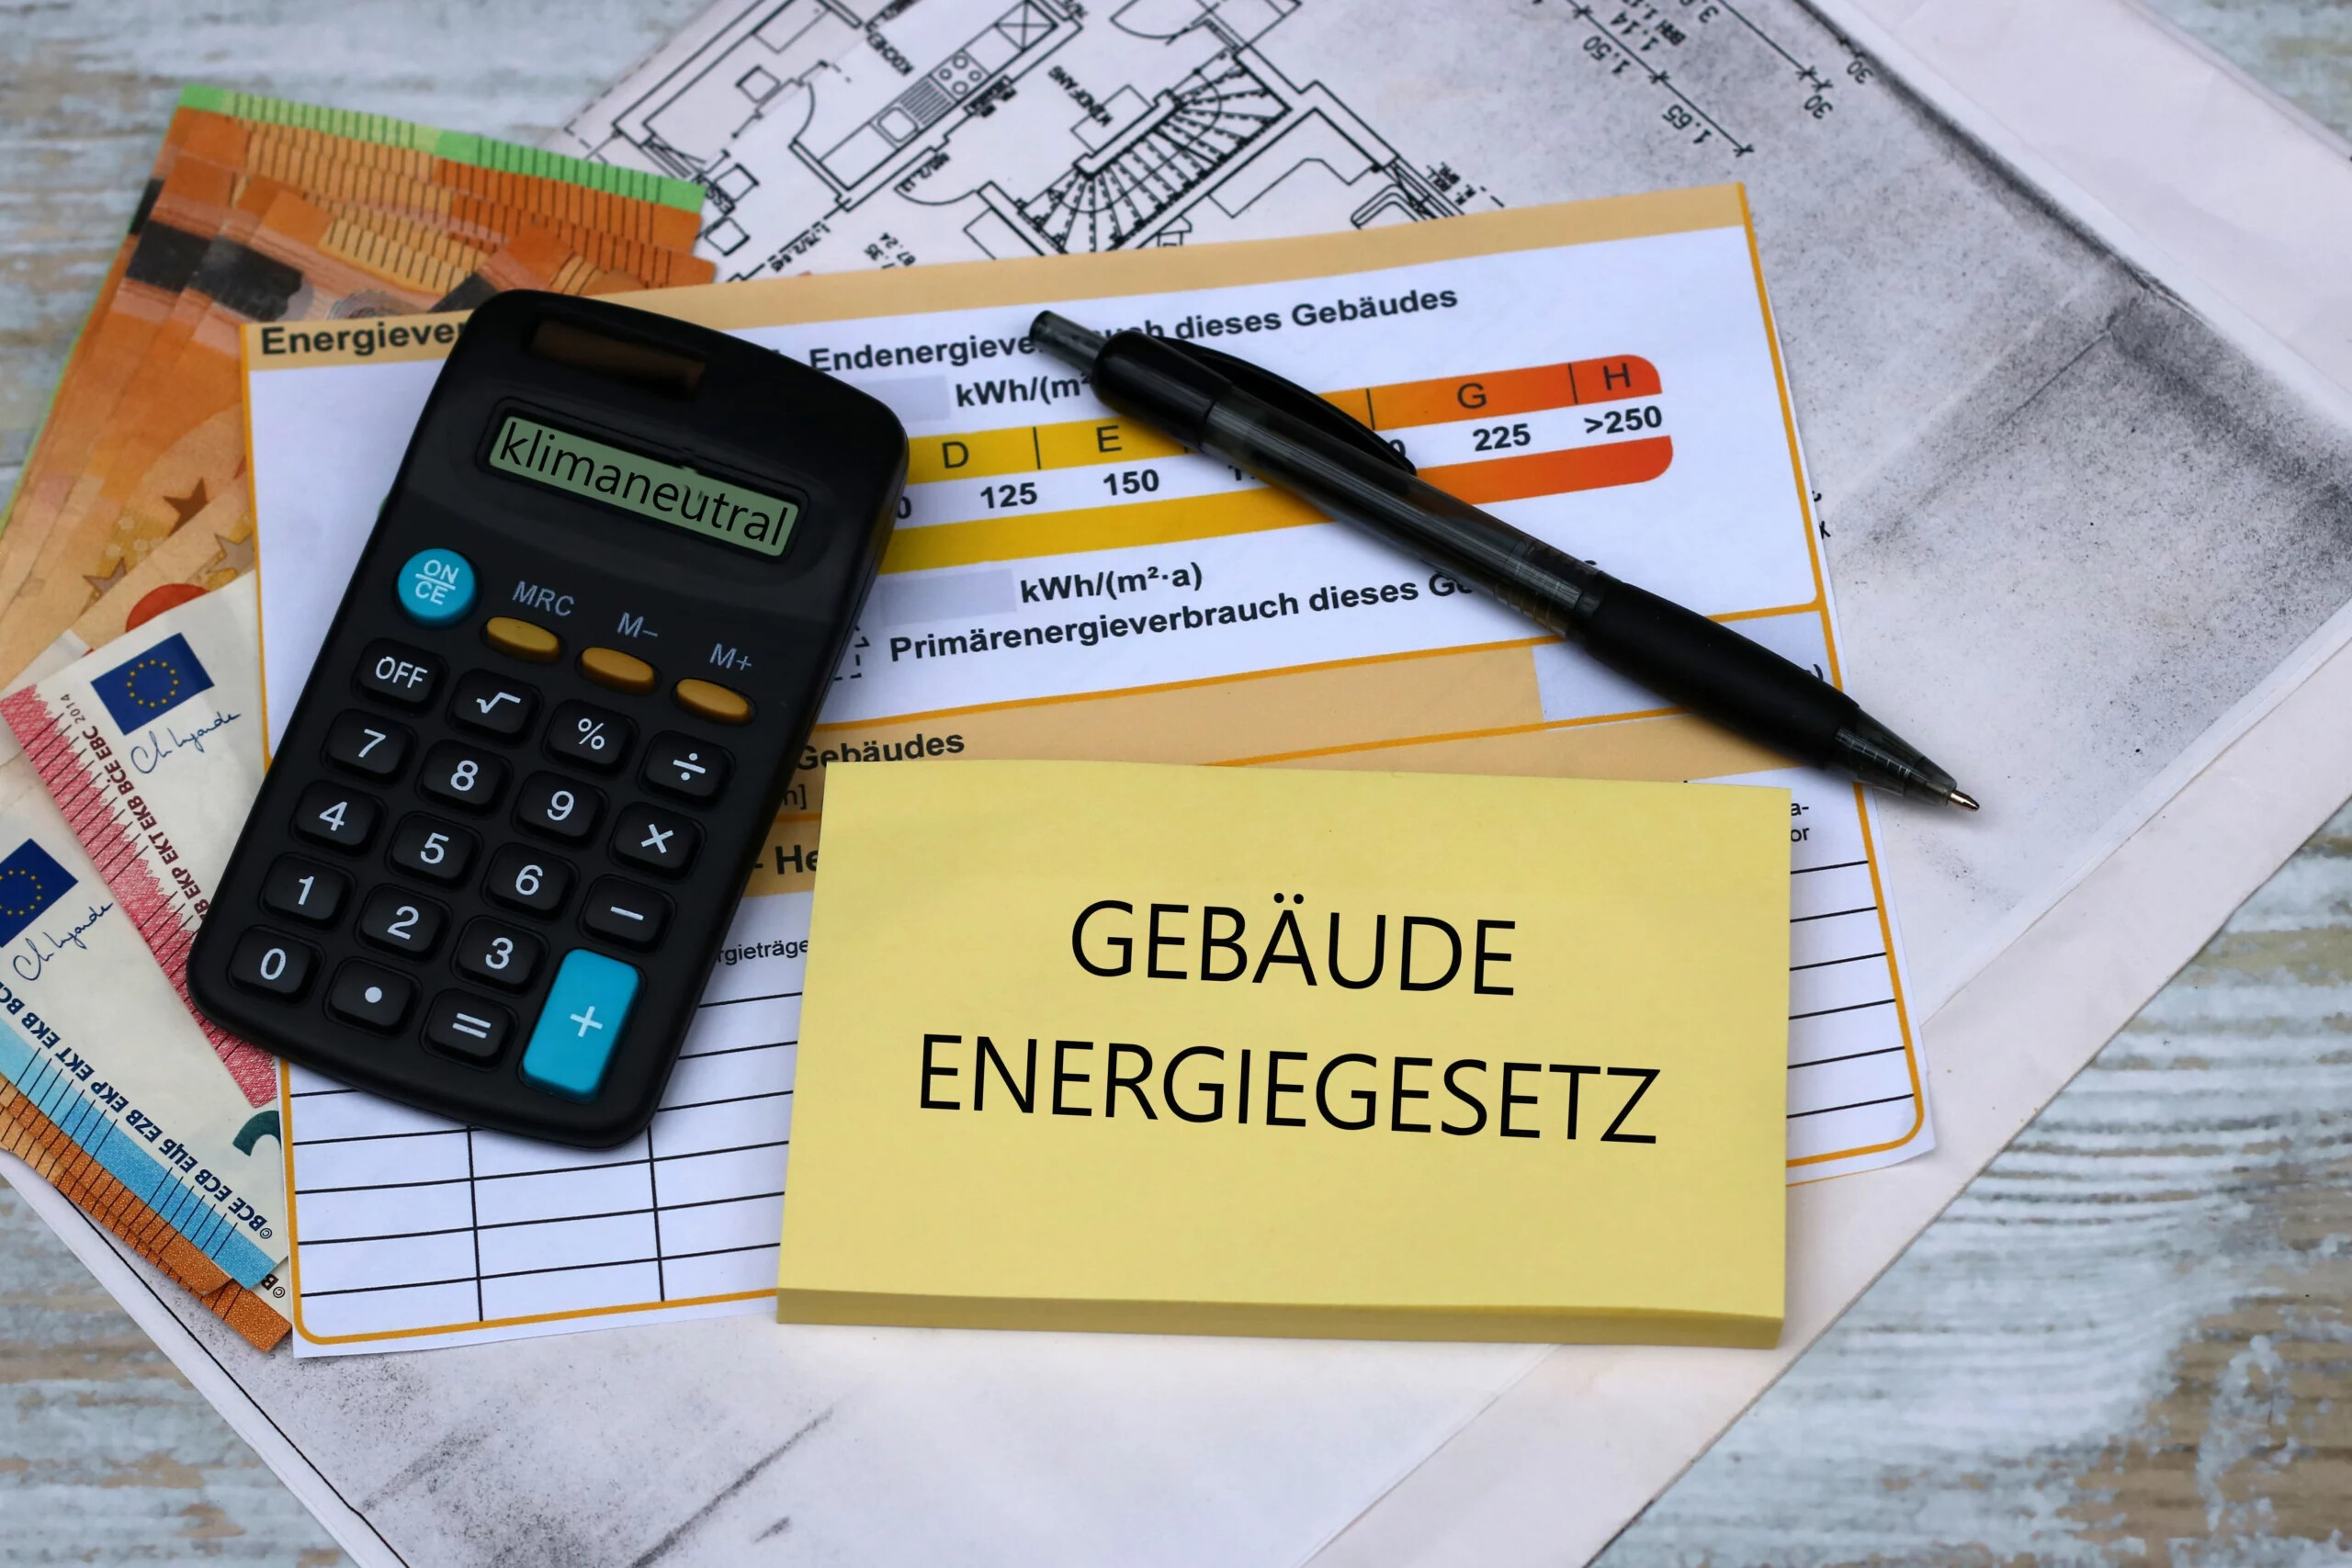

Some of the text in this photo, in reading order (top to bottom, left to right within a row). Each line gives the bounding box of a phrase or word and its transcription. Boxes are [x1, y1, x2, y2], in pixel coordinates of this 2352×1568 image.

[1583, 35, 1631, 75] 1.50
[1846, 60, 1874, 85] 30
[1662, 105, 1712, 144] 1.65
[1804, 95, 1833, 119] 30
[878, 231, 917, 266] 87.24
[1175, 313, 1282, 340] dieses
[1291, 289, 1458, 327] Gebäudes
[942, 362, 1631, 469] D E G H
[979, 405, 1663, 509] 125 150 225 >250
[500, 422, 788, 547] klimaneutral
[424, 559, 459, 582] ON
[414, 581, 447, 605] CE
[512, 581, 575, 617] MRC
[889, 593, 1298, 661] Primärenergieverbrauch
[1309, 582, 1419, 612] dieses
[375, 656, 428, 689] OFF
[709, 643, 752, 671] M+
[61, 694, 85, 724] 2014
[82, 726, 112, 761] EBC
[357, 728, 387, 758] 7
[450, 760, 479, 792] 8
[547, 790, 574, 821] 9
[127, 795, 157, 830] EKB
[148, 831, 178, 864] EKT
[319, 801, 348, 831] 4
[420, 832, 449, 864] 5
[515, 864, 543, 896] 6
[171, 867, 201, 899] EKP
[298, 875, 315, 906] 1
[387, 906, 419, 940] 2
[485, 937, 514, 970] 3
[1071, 892, 1516, 997] GEBÄUDE
[260, 948, 287, 980] 0
[21, 1012, 61, 1049] EKB
[54, 1047, 95, 1081] EKT
[90, 1081, 130, 1113] EKP
[920, 1033, 1661, 1145] ENERGIEGESETZ
[125, 1109, 163, 1143] EZB
[194, 1168, 232, 1202] ECB
